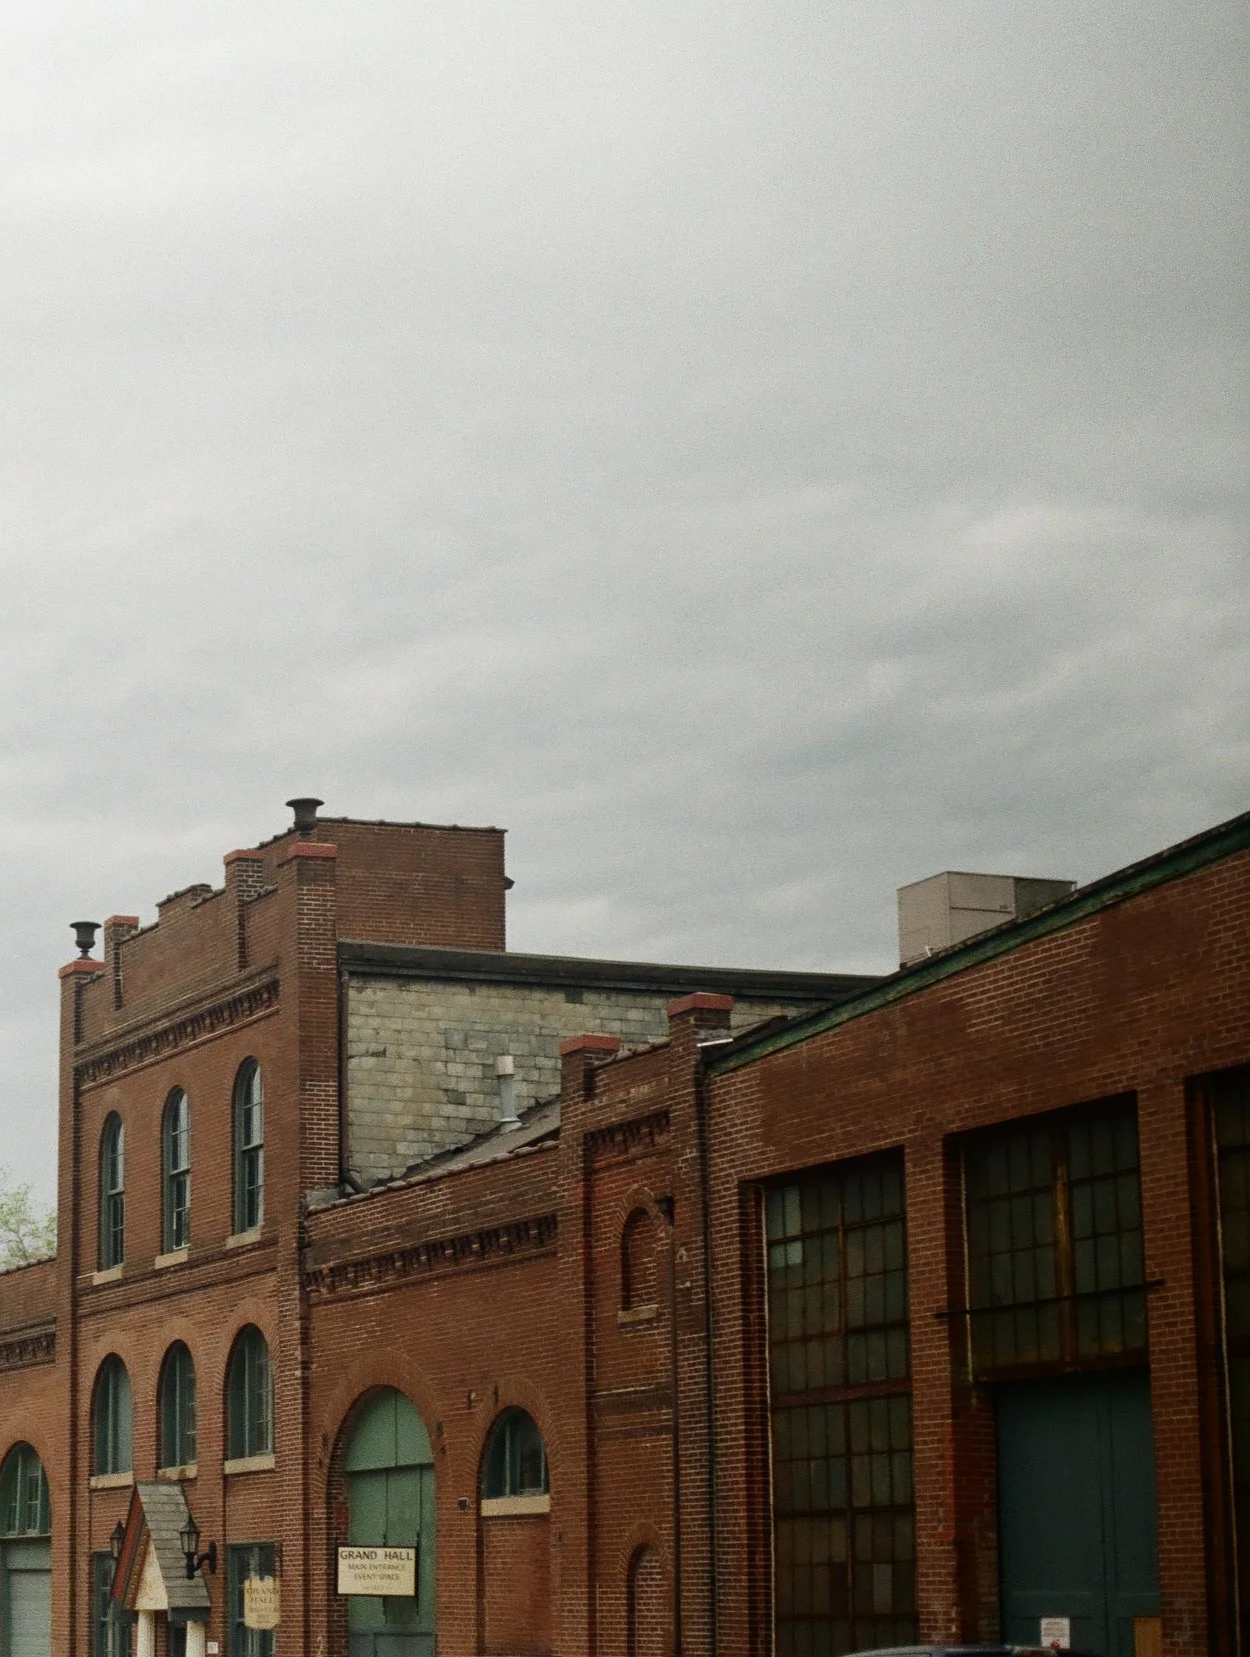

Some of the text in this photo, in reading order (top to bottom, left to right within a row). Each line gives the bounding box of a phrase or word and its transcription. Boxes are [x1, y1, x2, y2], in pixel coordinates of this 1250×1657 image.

[340, 1550, 414, 1561] GRAND HALL
[370, 1563, 406, 1571] ENTRANCE
